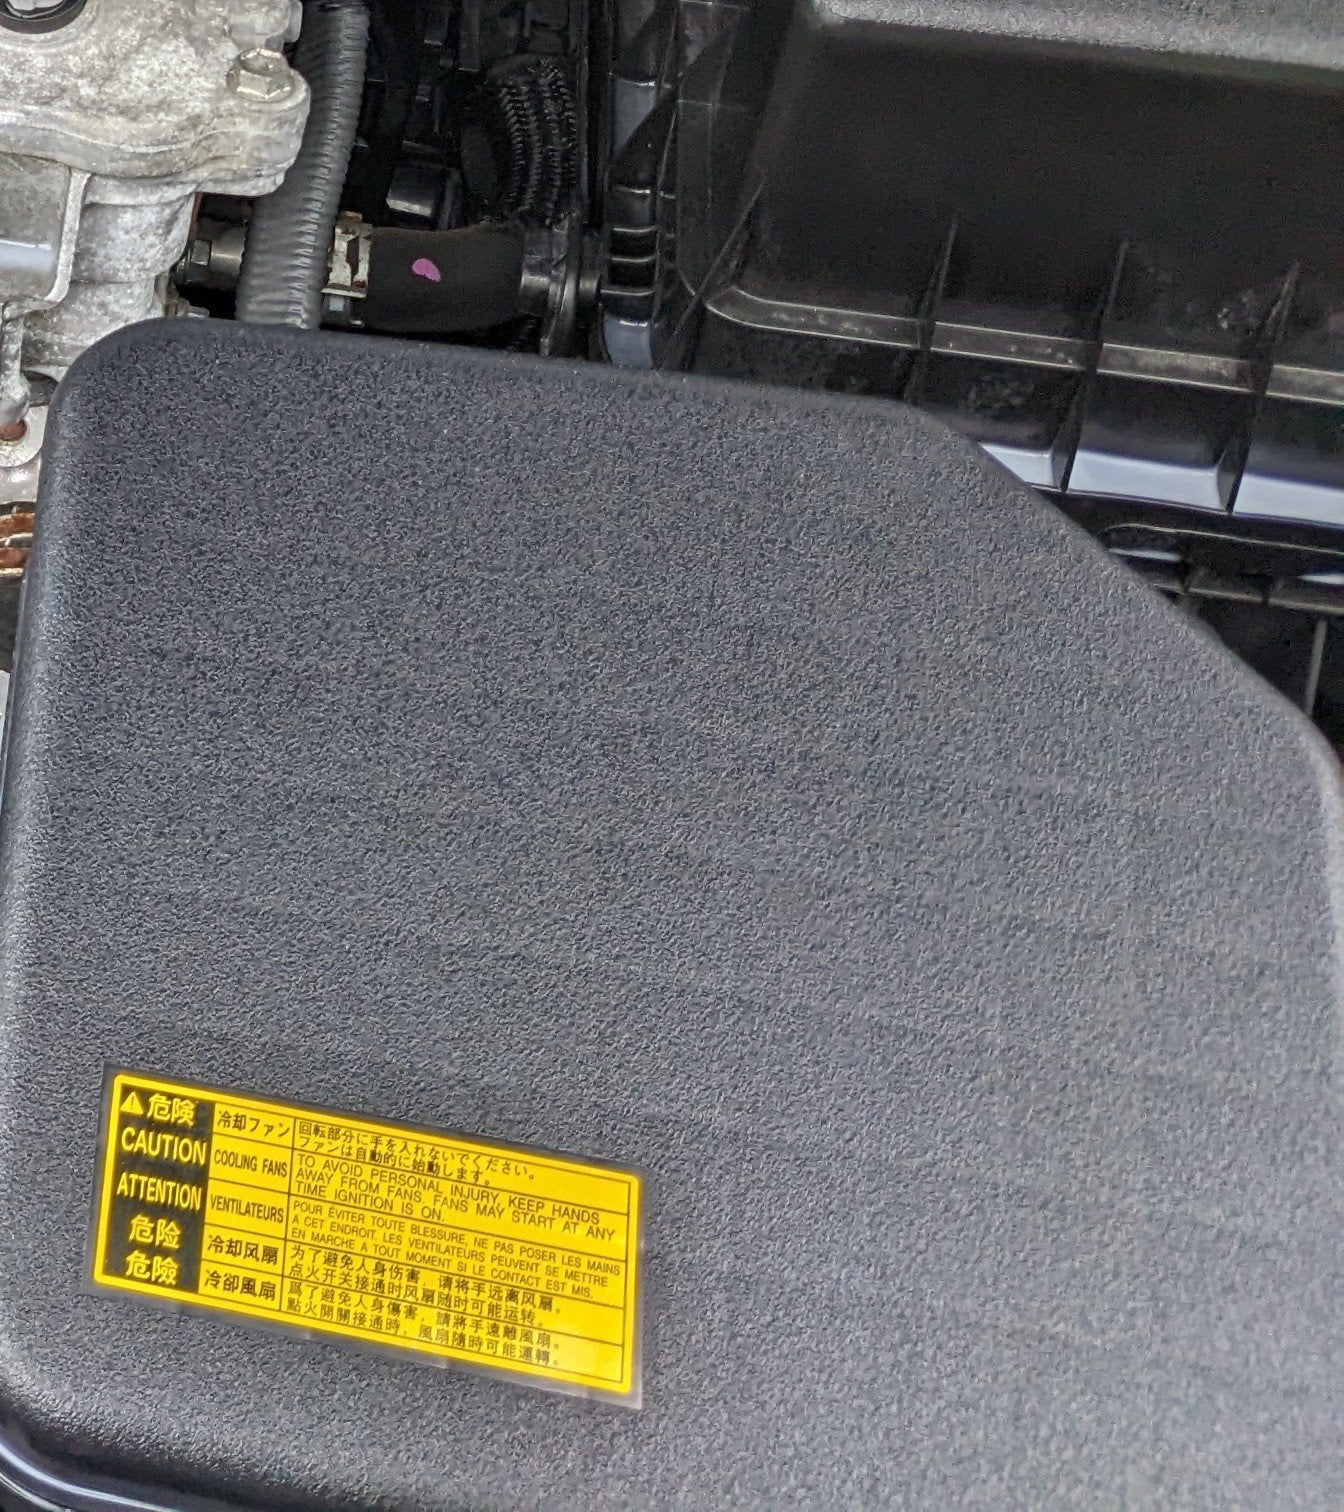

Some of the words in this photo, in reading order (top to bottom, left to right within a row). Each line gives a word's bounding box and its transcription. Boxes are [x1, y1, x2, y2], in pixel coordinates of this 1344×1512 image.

[147, 1092, 195, 1126] 危険
[217, 1109, 289, 1140] 冷却ファン
[120, 1125, 207, 1166] CAUTION
[213, 1148, 258, 1172] COOLING
[261, 1157, 288, 1178] FANS
[116, 1170, 202, 1211] ATTENTION
[295, 1180, 326, 1197] TIME
[334, 1188, 393, 1211] IGNITION
[401, 1201, 413, 1215] IS
[296, 1167, 333, 1186] AWAY
[340, 1175, 379, 1195] FROM
[433, 1194, 468, 1213] FANS
[475, 1202, 505, 1220] MAY
[511, 1209, 554, 1230] START
[562, 1219, 578, 1235] AT
[586, 1224, 615, 1242] ANY
[297, 1153, 315, 1168] TO
[322, 1158, 363, 1177] AVOID
[370, 1167, 443, 1193] PERSONAL
[508, 1195, 545, 1213] KEEP
[551, 1203, 600, 1224] HANDS
[209, 1193, 284, 1224] VENTILATEURS
[128, 1212, 181, 1250] 危险
[207, 1233, 278, 1265] 冷却风扇
[293, 1200, 322, 1215] POUR
[328, 1204, 365, 1224] ÉVITER
[370, 1215, 405, 1232] TOUTE
[473, 1236, 488, 1249] NE
[493, 1240, 514, 1254] PAS
[519, 1245, 555, 1263] POSER
[561, 1254, 581, 1268] LES
[587, 1259, 620, 1276] MAINS
[125, 1248, 178, 1285] 危險
[291, 1227, 305, 1239] EN
[310, 1231, 355, 1249] MARCHE
[373, 1243, 400, 1259] TOUT
[405, 1250, 451, 1269] MOMENT
[456, 1260, 466, 1272] SI
[472, 1264, 485, 1276] LE
[490, 1267, 540, 1287] CONTACT
[546, 1278, 565, 1293] EST
[304, 1216, 324, 1229] CET
[382, 1232, 402, 1245] LES
[408, 1237, 485, 1262] VENTILATEURS
[490, 1254, 540, 1273] PEUVENT
[545, 1265, 559, 1277] SE
[564, 1269, 608, 1287] METTRE
